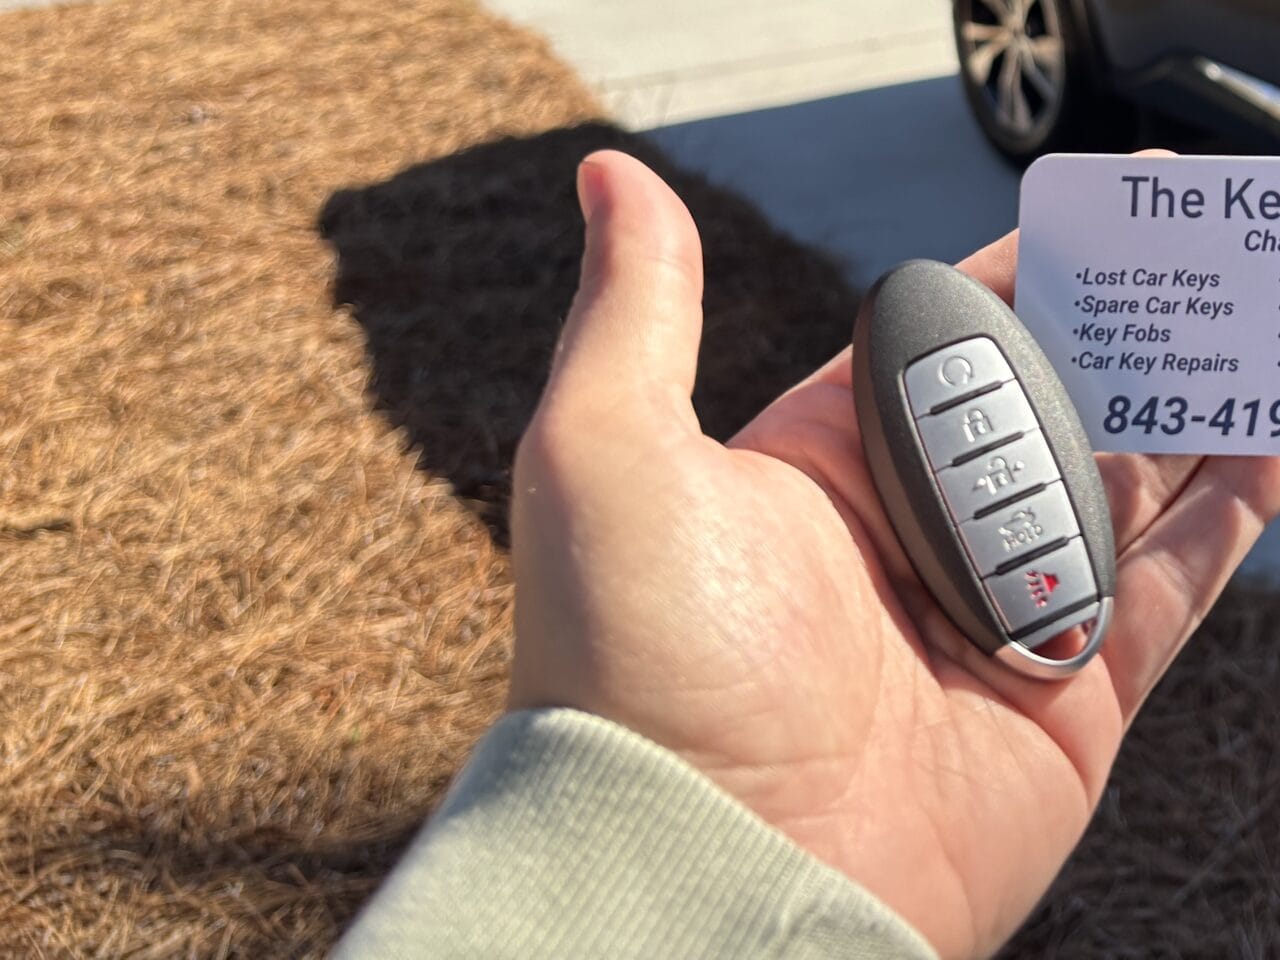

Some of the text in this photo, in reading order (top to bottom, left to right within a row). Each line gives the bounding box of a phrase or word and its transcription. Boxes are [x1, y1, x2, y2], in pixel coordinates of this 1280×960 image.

[1121, 175, 1205, 219] The
[1082, 267, 1221, 292] Lost Car Keys
[1080, 295, 1235, 321] Spare Car Keys
[1079, 323, 1172, 346] Key Fobs
[1078, 351, 1240, 376] Car Key Repairs
